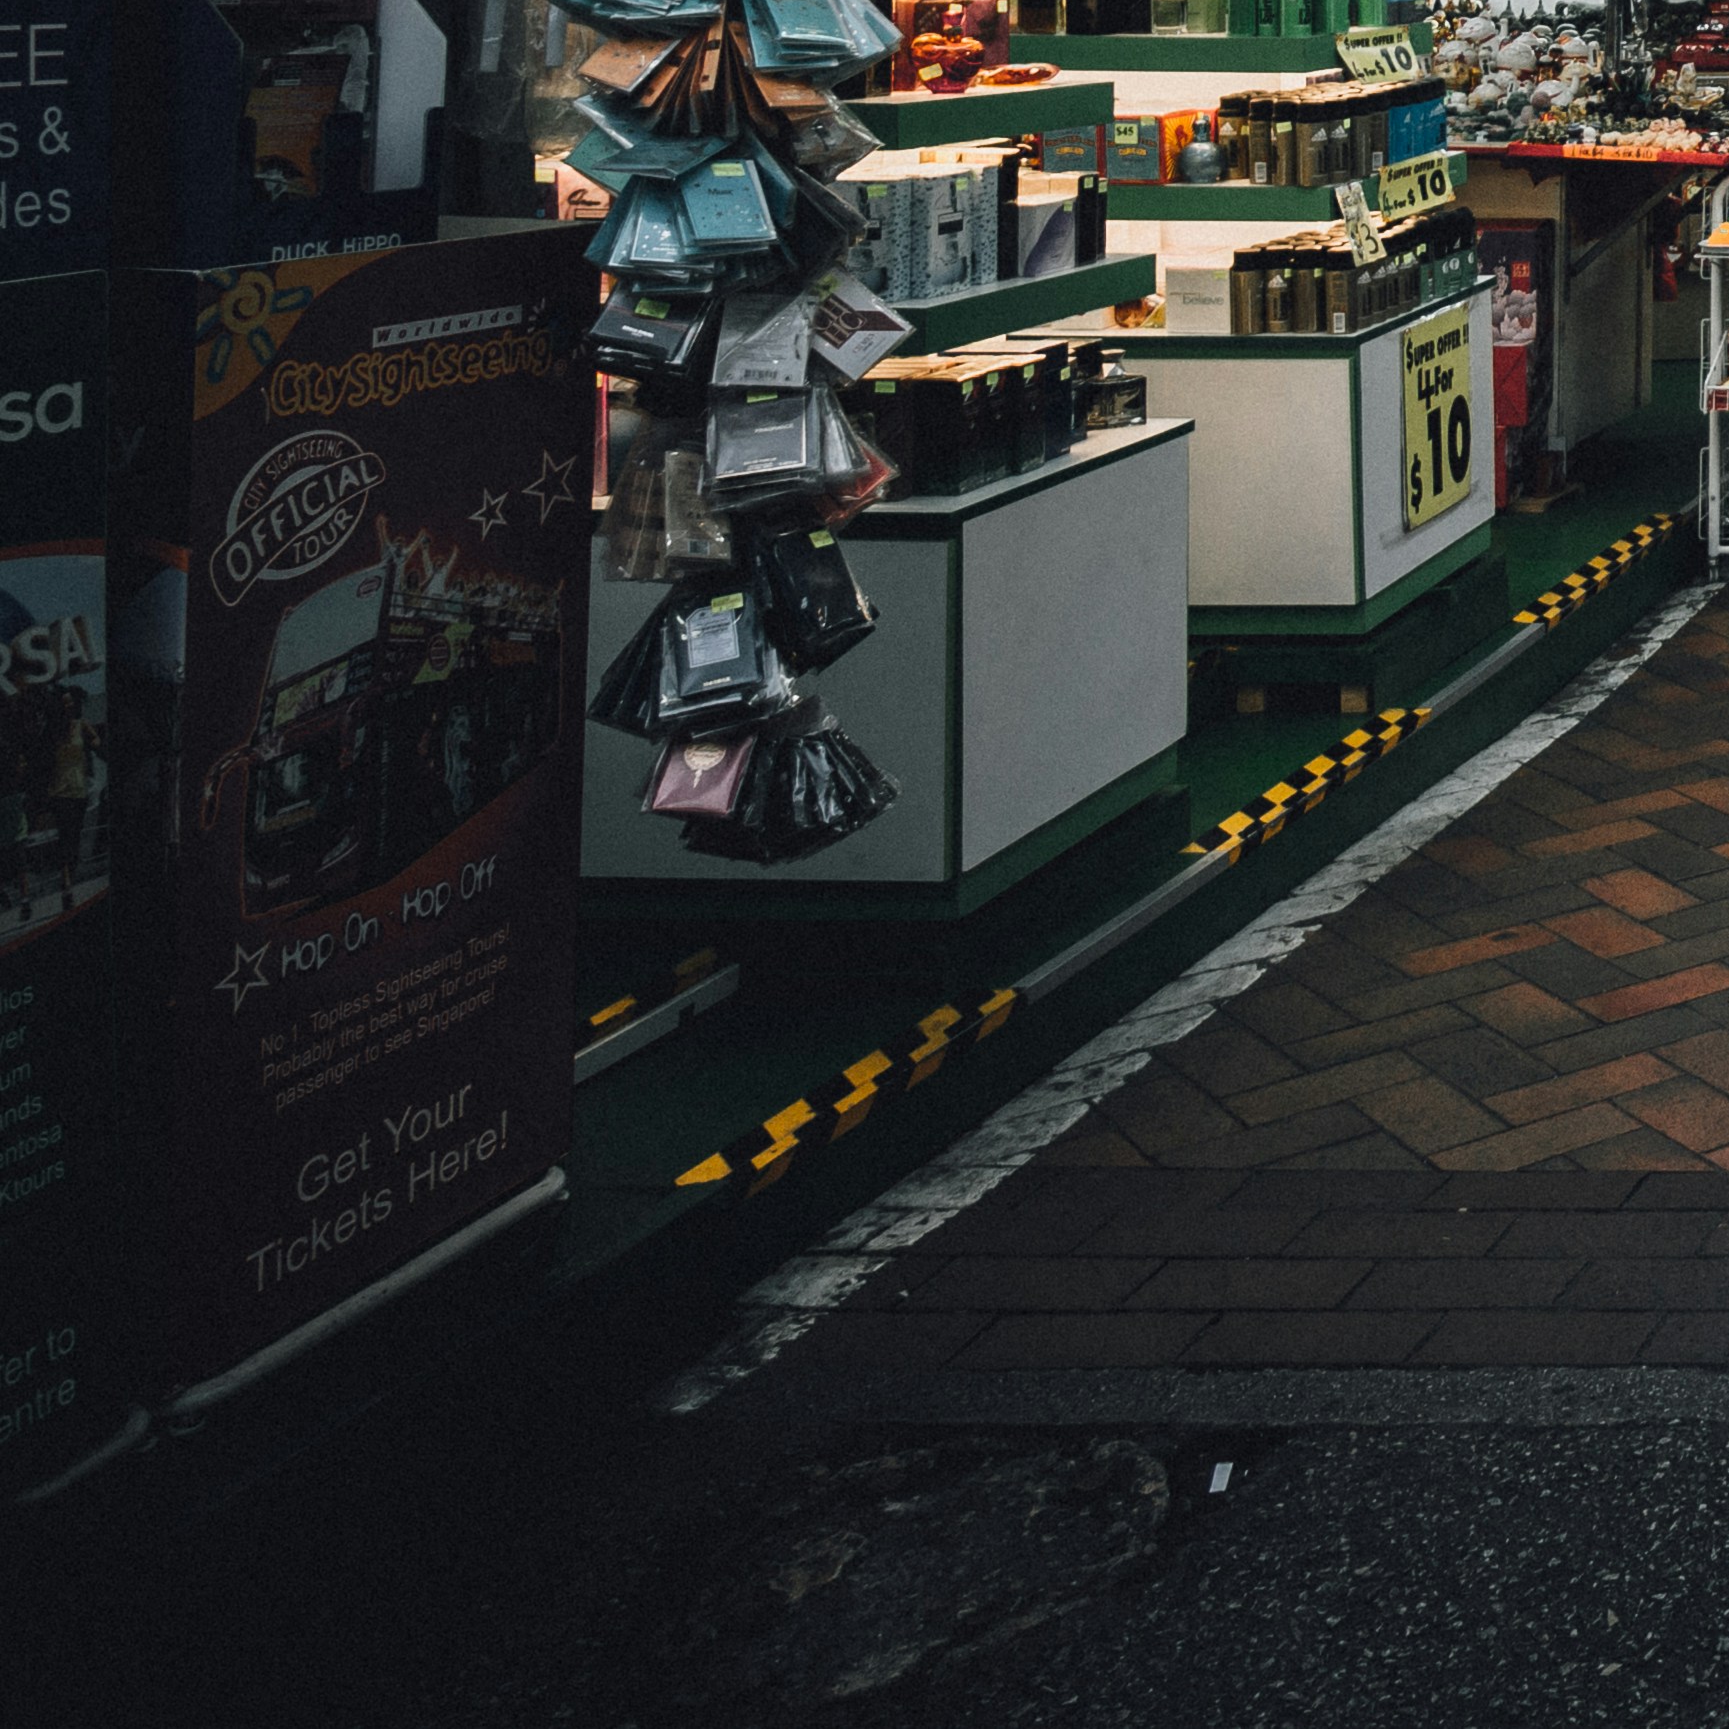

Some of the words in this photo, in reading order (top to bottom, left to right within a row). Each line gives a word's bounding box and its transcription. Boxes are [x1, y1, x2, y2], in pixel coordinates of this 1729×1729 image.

[1373, 33, 1395, 48] OFFER
[1382, 46, 1413, 71] 10
[39, 106, 72, 156] &
[1115, 126, 1134, 137] $45
[1412, 159, 1435, 177] OFFER
[1417, 169, 1447, 201] 10
[271, 239, 330, 264] DUCK
[377, 309, 518, 344] Worldwide
[1437, 328, 1461, 356] OFFER
[271, 329, 551, 417] CitySightseeing
[1434, 364, 1454, 397] For
[265, 439, 344, 480] SIGHTSEEING
[1427, 394, 1472, 497] 10
[225, 459, 380, 583] OFFICIAL
[294, 506, 354, 564] TOUR
[311, 994, 372, 1032] Topless
[375, 948, 463, 1004] Sightseeing
[261, 1043, 335, 1087] Probably
[340, 1026, 365, 1050] the
[369, 1006, 403, 1035] best
[407, 994, 437, 1022] way
[440, 976, 460, 1000] for
[464, 955, 509, 987] cruise
[275, 1065, 362, 1115] passenger
[364, 1048, 381, 1064] to
[384, 1031, 414, 1054] see
[416, 982, 497, 1043] Singapore!
[296, 1132, 372, 1203] Get
[384, 1084, 472, 1154] Your
[246, 1186, 394, 1292] Tickets
[407, 1109, 509, 1203] Here!
[47, 1326, 77, 1361] to
